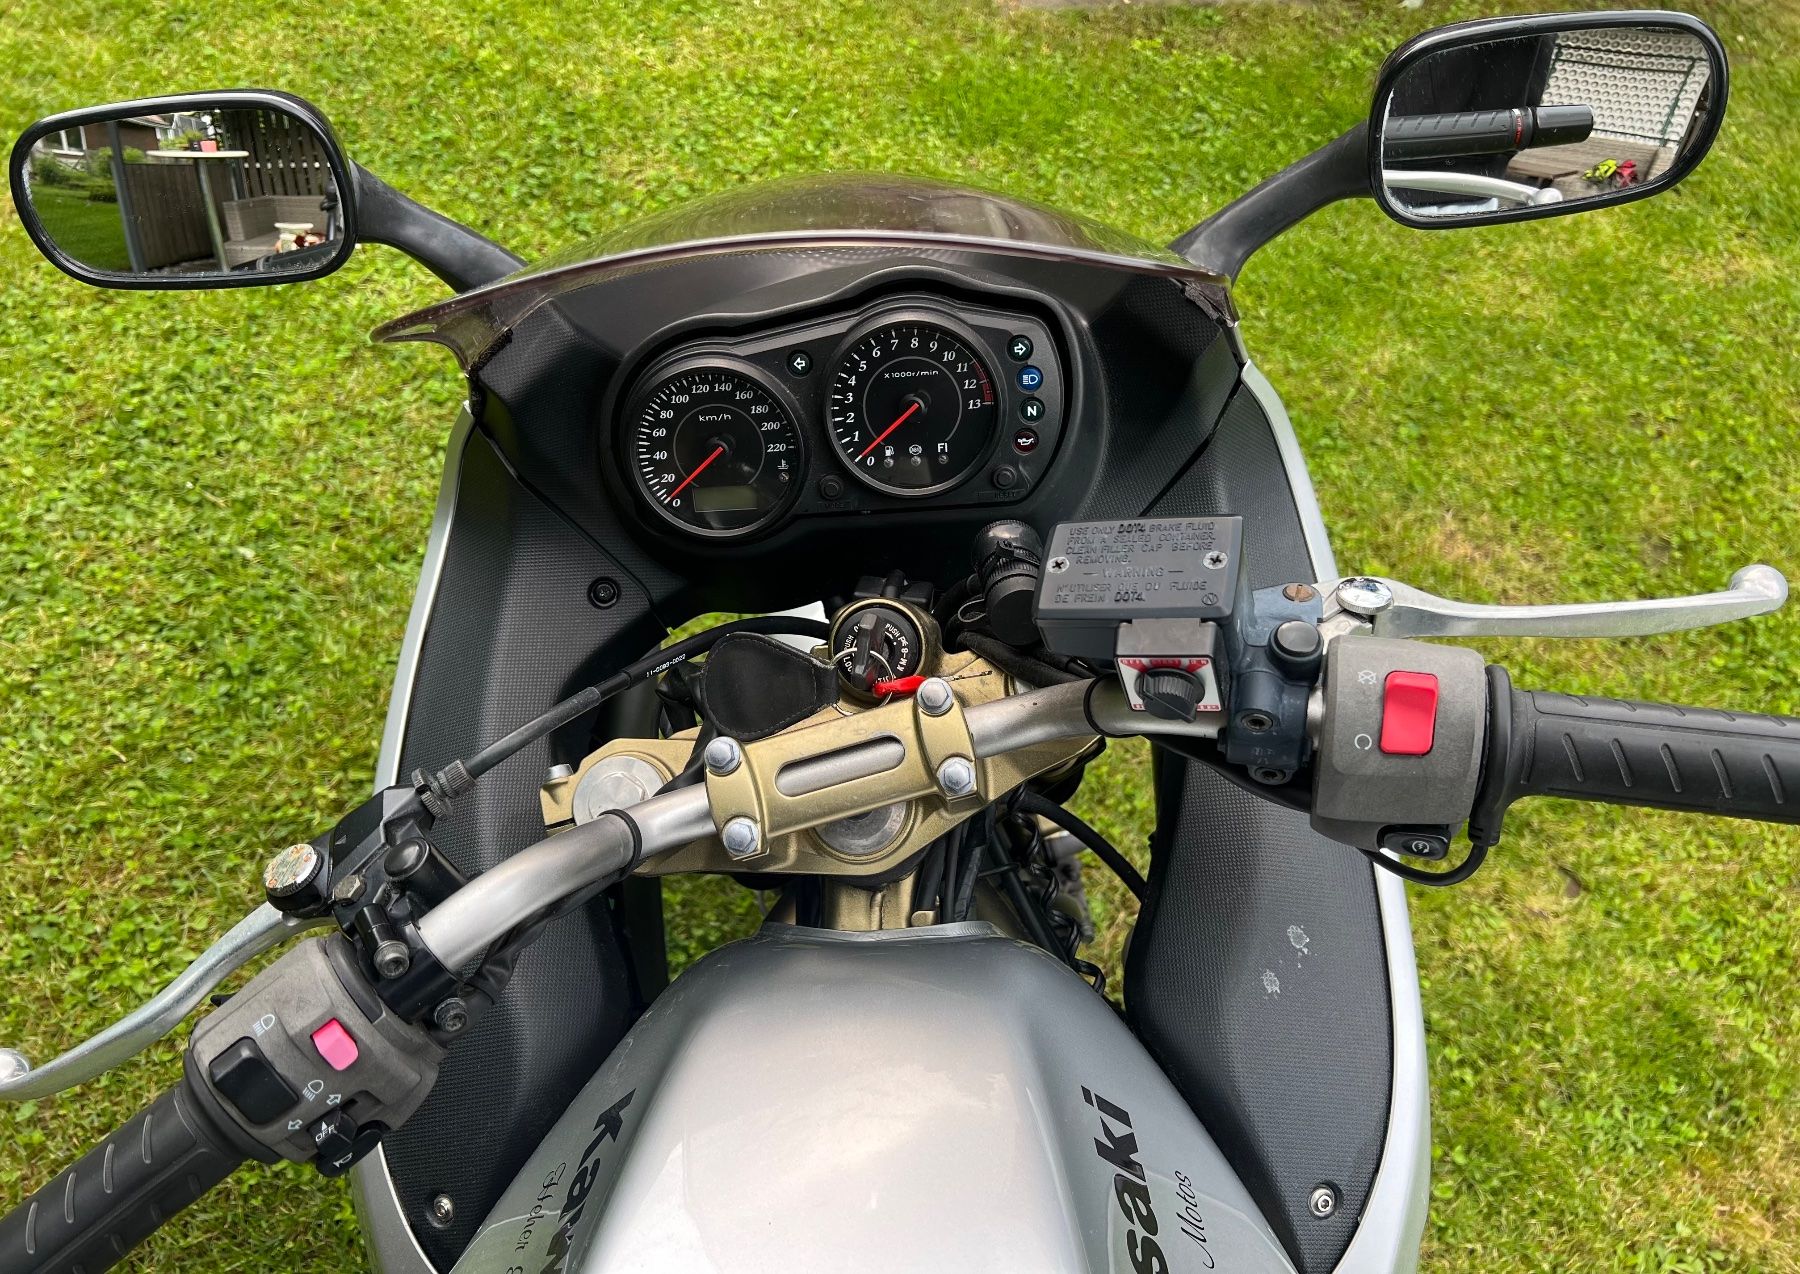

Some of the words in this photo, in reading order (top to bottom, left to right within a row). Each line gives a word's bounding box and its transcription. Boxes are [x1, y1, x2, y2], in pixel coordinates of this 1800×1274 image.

[890, 339, 899, 351] 7
[910, 337, 920, 348] 8
[929, 341, 938, 353] 9
[872, 346, 881, 358] 6
[942, 351, 956, 362] 10
[858, 361, 867, 372] 5
[956, 362, 969, 373] 11
[848, 376, 857, 386] 4
[963, 379, 977, 390] 12
[691, 384, 710, 394] 120
[713, 383, 732, 392] 140
[671, 395, 690, 404] 100
[735, 391, 754, 400] 160
[844, 393, 854, 404] 3
[750, 404, 769, 414] 180
[967, 399, 982, 410] 13
[660, 410, 674, 419] 80
[1027, 406, 1037, 417] N
[699, 413, 732, 422] km/h
[846, 413, 855, 424] 2
[761, 422, 780, 431] 200
[652, 428, 666, 437] 60
[853, 431, 860, 442] 1
[767, 443, 786, 453] 220
[937, 443, 948, 453] FI
[653, 451, 667, 460] 40
[866, 456, 875, 466] 0
[661, 474, 675, 483] 20
[672, 498, 681, 507] 0
[1069, 527, 1089, 536] USE
[1091, 525, 1115, 535] ONLY
[1117, 523, 1146, 534] DOT4
[1150, 523, 1182, 533] BRAKE
[1185, 521, 1215, 531] FLUID
[1067, 536, 1095, 546] FROM
[1113, 534, 1150, 544] SEALED
[1065, 545, 1097, 555] CLEAN
[1100, 544, 1134, 554] FILLER
[1141, 543, 1163, 552] CAP
[1171, 541, 1213, 552] BEFORE
[1103, 568, 1164, 578] WARNING
[1118, 582, 1139, 592] QUE
[1145, 582, 1159, 591] DU
[1169, 581, 1207, 591] FLUIDE
[1054, 594, 1069, 604] DE
[1074, 593, 1105, 603] FREIN
[885, 623, 901, 638] PUSH
[897, 648, 909, 672] KM-8
[315, 1124, 336, 1142] OFF
[1175, 1170, 1215, 1270] Motos
